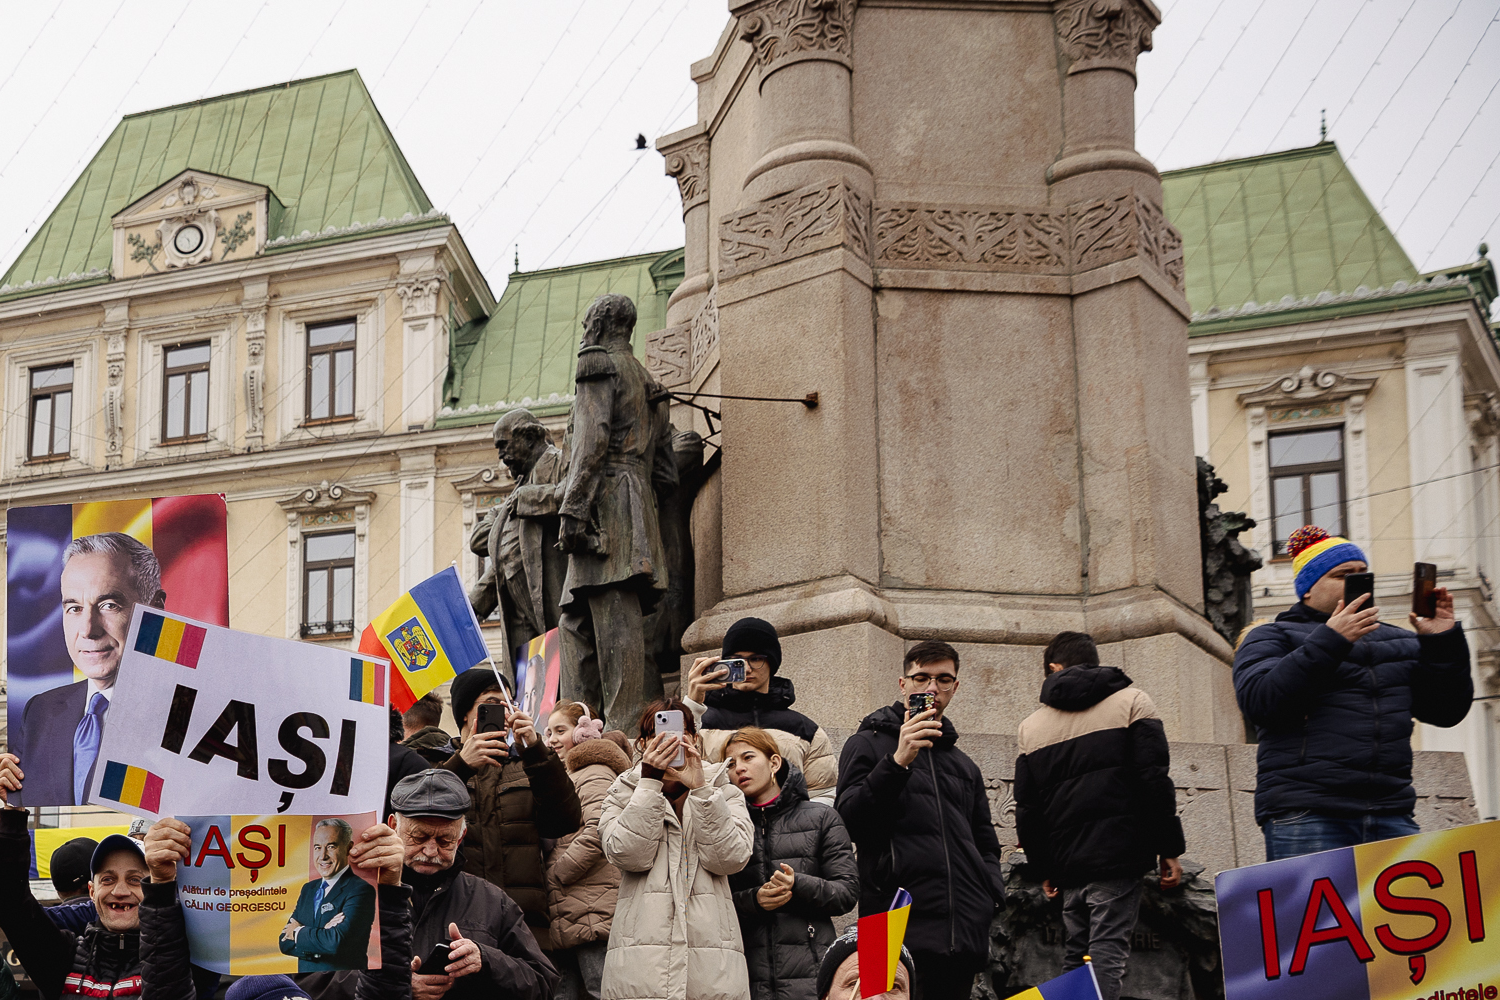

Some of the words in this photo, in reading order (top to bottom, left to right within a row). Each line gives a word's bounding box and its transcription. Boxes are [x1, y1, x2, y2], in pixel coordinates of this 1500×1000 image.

[160, 683, 357, 814] IAȘI
[182, 884, 212, 896] Alături
[213, 887, 227, 896] de
[229, 886, 288, 899] președintele
[184, 898, 214, 911] CĂLIN
[216, 901, 286, 912] GEORGESCU
[1257, 850, 1485, 986] IAȘI
